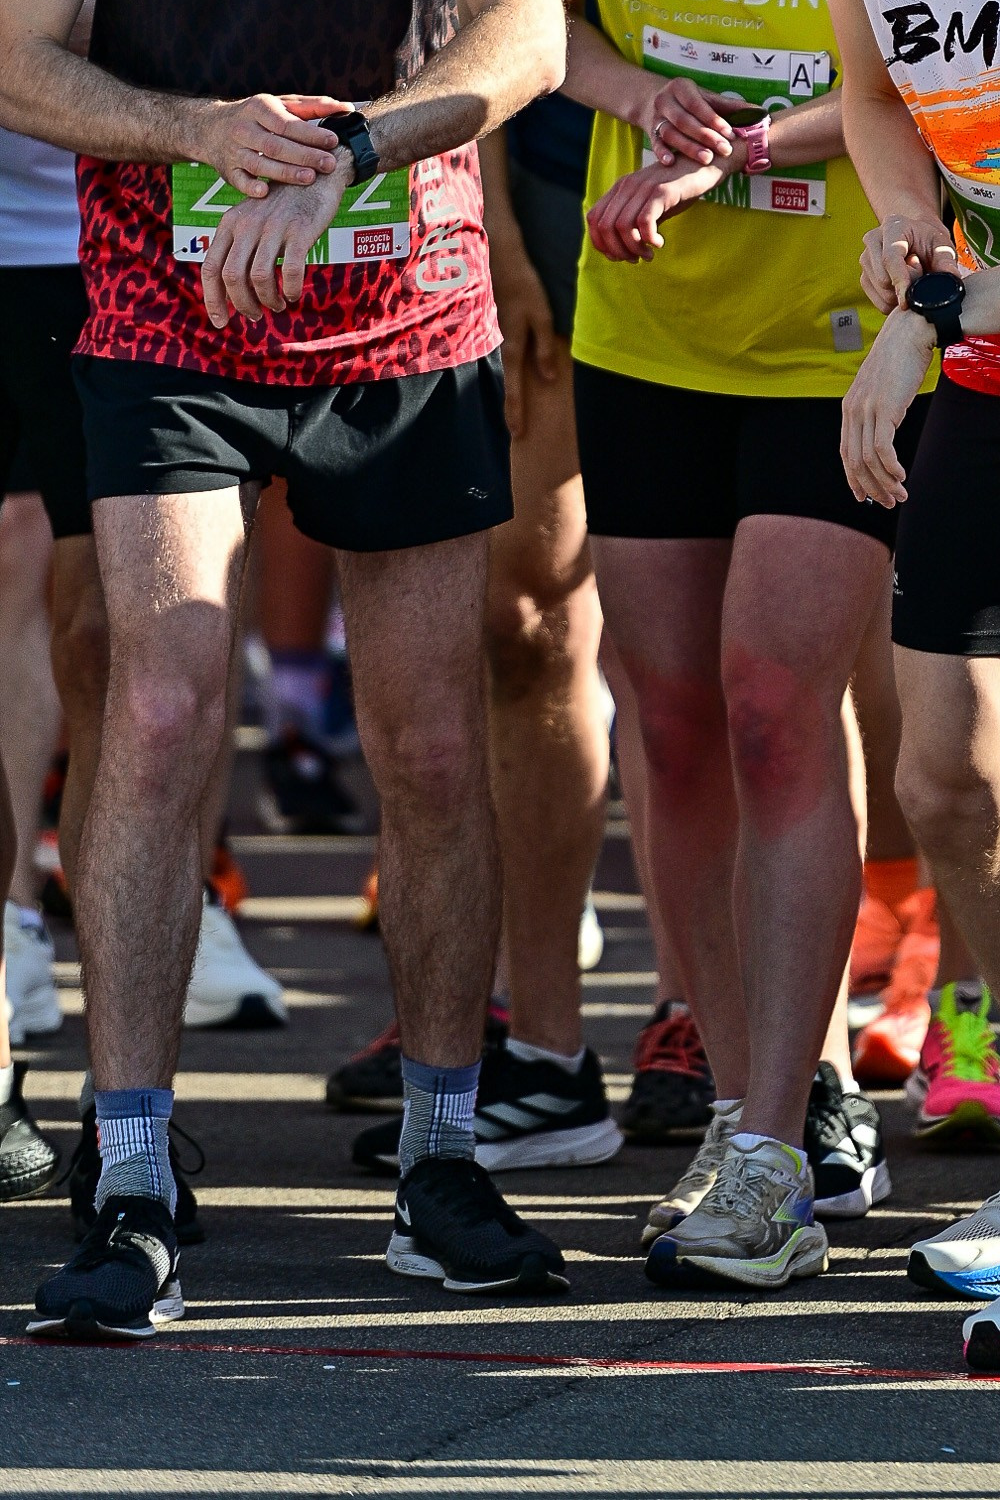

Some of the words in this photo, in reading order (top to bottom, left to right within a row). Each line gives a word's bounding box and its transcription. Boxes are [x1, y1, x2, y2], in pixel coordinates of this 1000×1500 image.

[673, 11, 765, 31] компаний
[792, 63, 812, 89] A
[357, 244, 375, 254] 89.2
[376, 242, 390, 253] FM
